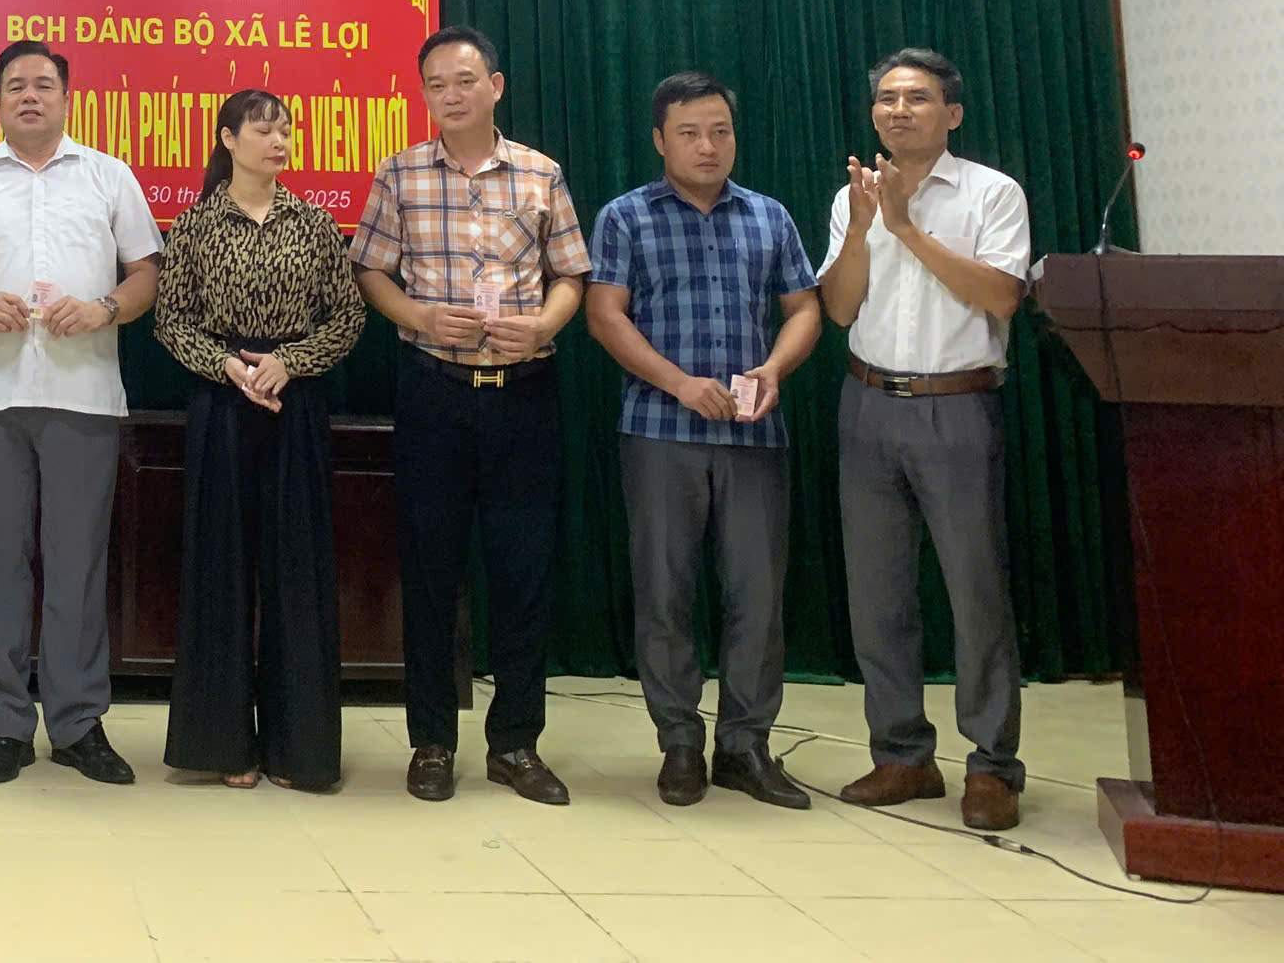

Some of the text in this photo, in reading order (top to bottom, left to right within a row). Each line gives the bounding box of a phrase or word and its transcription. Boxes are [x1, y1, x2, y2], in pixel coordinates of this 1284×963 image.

[7, 5, 369, 57] BCH ĐẢNG BỘ XÃ LÊ LỢI
[105, 74, 133, 167] VÀ
[139, 76, 194, 168] PHÁT
[310, 79, 360, 172] VIÊN
[367, 74, 408, 173] MỚI
[147, 185, 172, 204] 30
[304, 189, 351, 209] 2025
